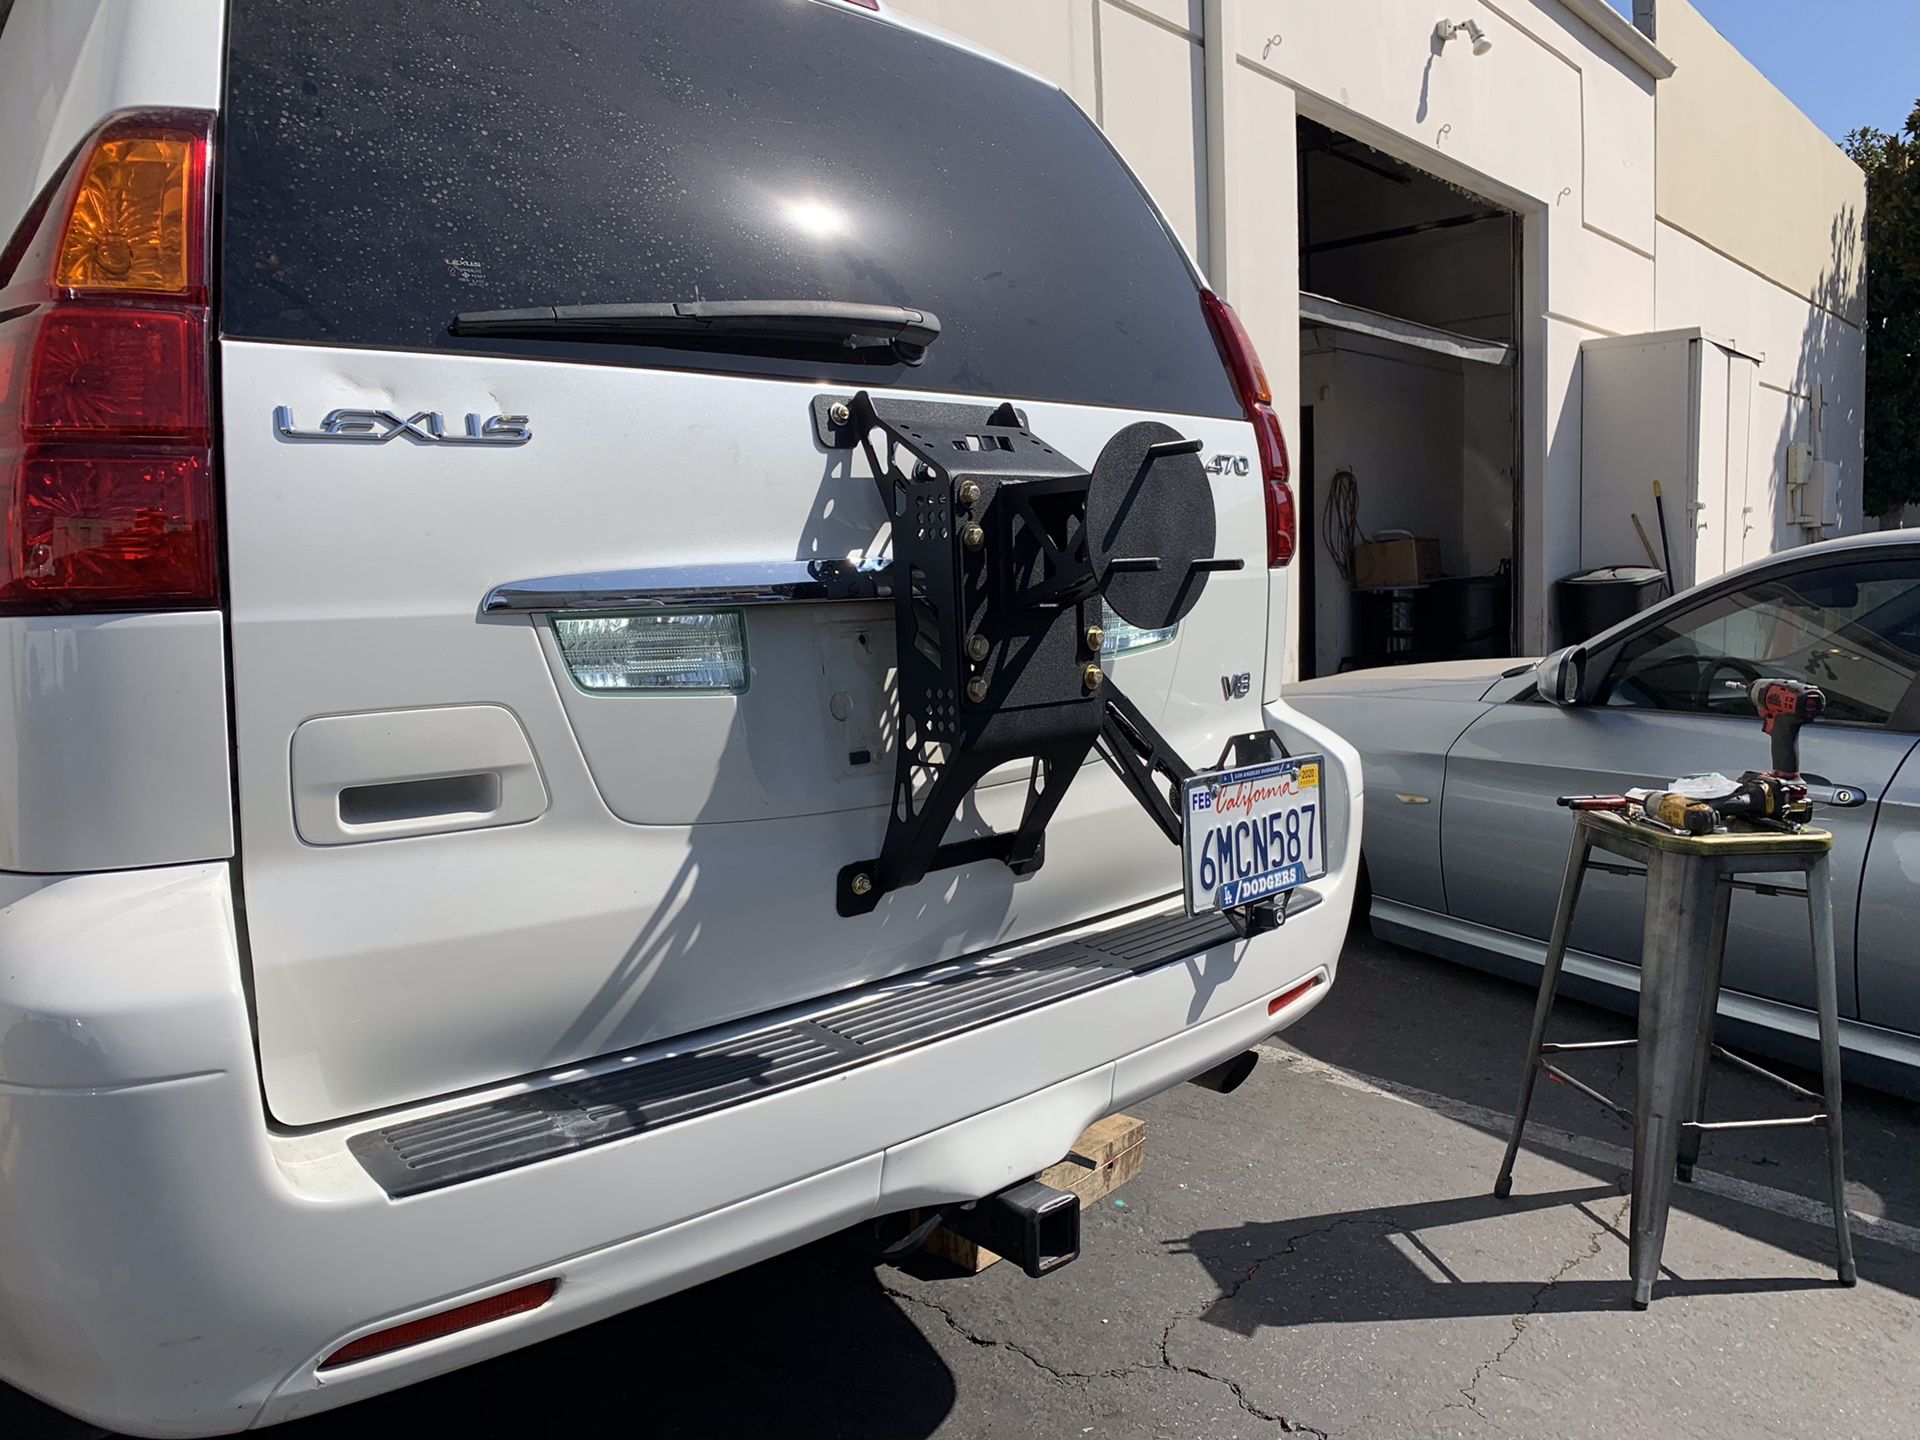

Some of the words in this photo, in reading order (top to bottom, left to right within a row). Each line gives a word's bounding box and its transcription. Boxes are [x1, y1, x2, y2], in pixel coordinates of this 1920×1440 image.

[273, 405, 532, 447] LEXUS
[1205, 454, 1249, 476] 470
[1221, 672, 1250, 701] V8
[1301, 768, 1315, 779] 2020
[1192, 792, 1211, 811] FEB
[1216, 780, 1299, 816] California
[1200, 804, 1315, 891] 6MCN587
[1242, 867, 1297, 898] DODGERS
